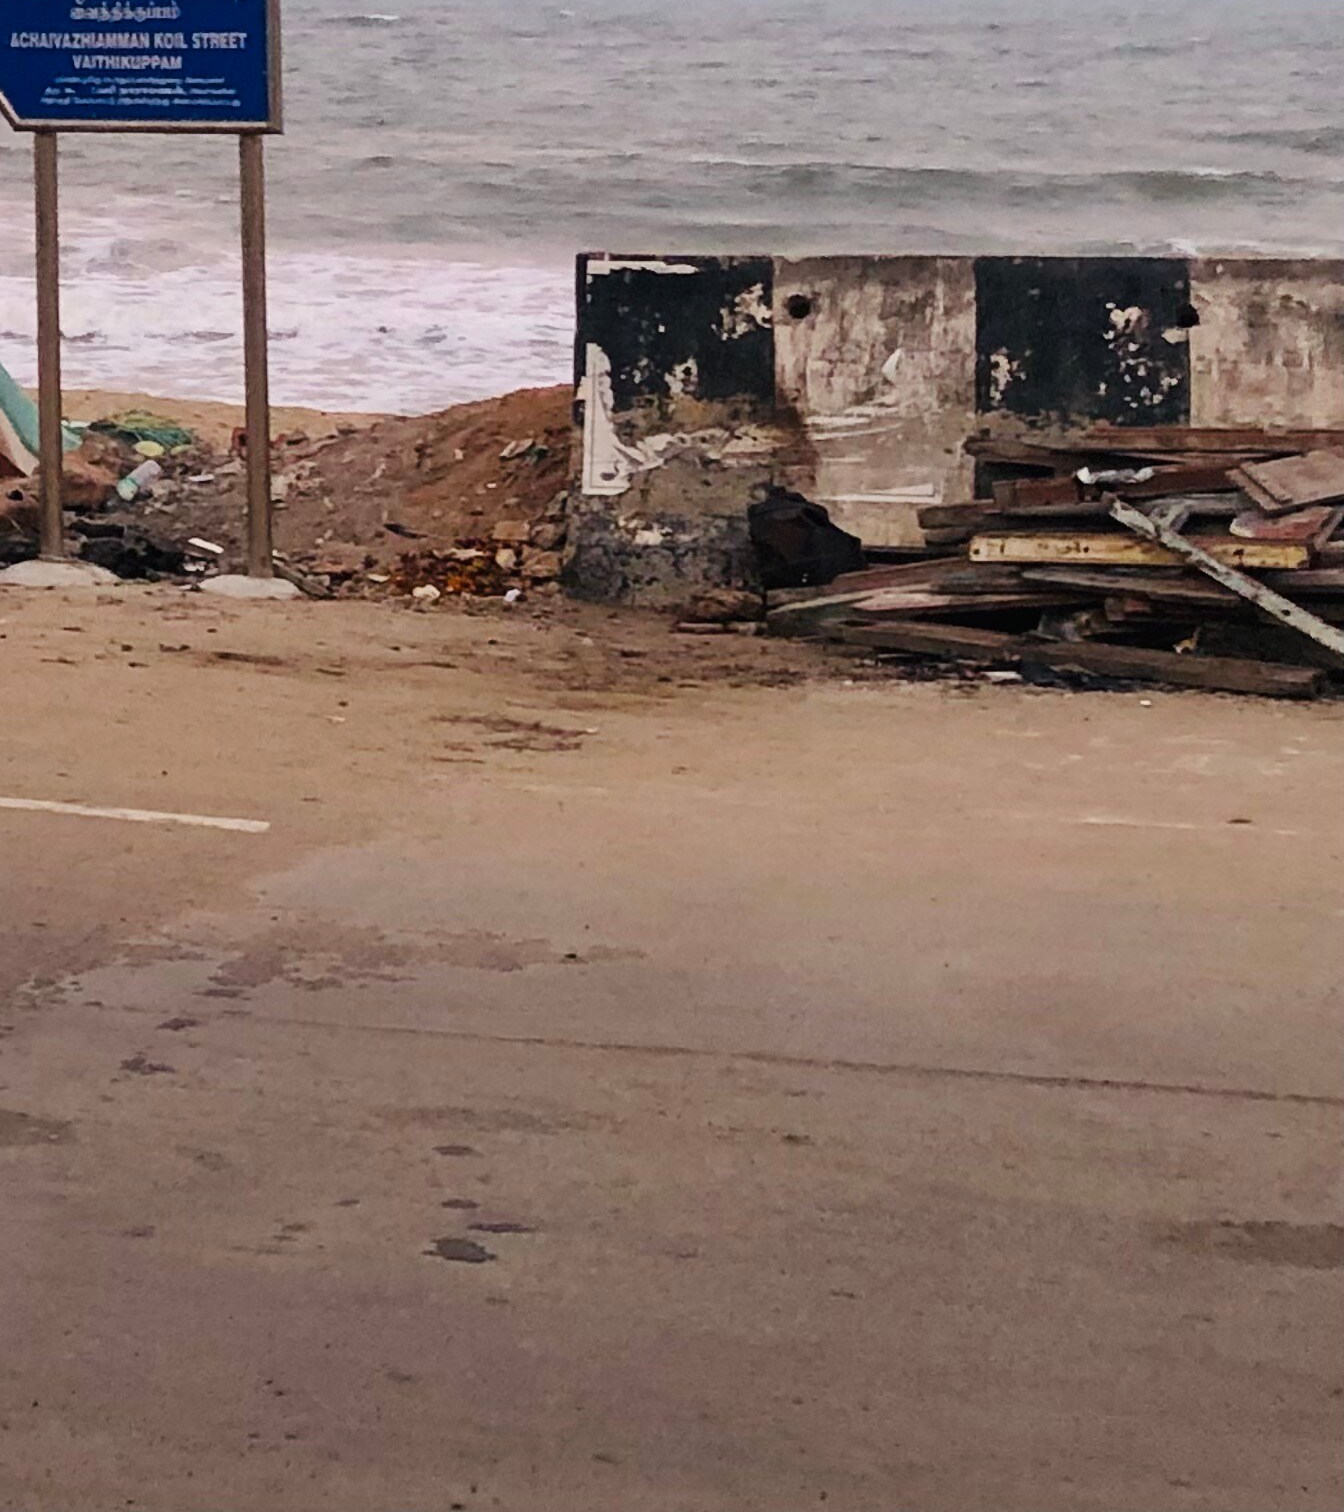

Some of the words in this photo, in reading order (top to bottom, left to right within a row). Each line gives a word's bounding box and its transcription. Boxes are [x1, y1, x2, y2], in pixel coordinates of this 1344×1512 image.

[153, 32, 188, 49] KOIL
[191, 32, 248, 49] STREET
[72, 54, 183, 69] VAITHIKUPPAM
